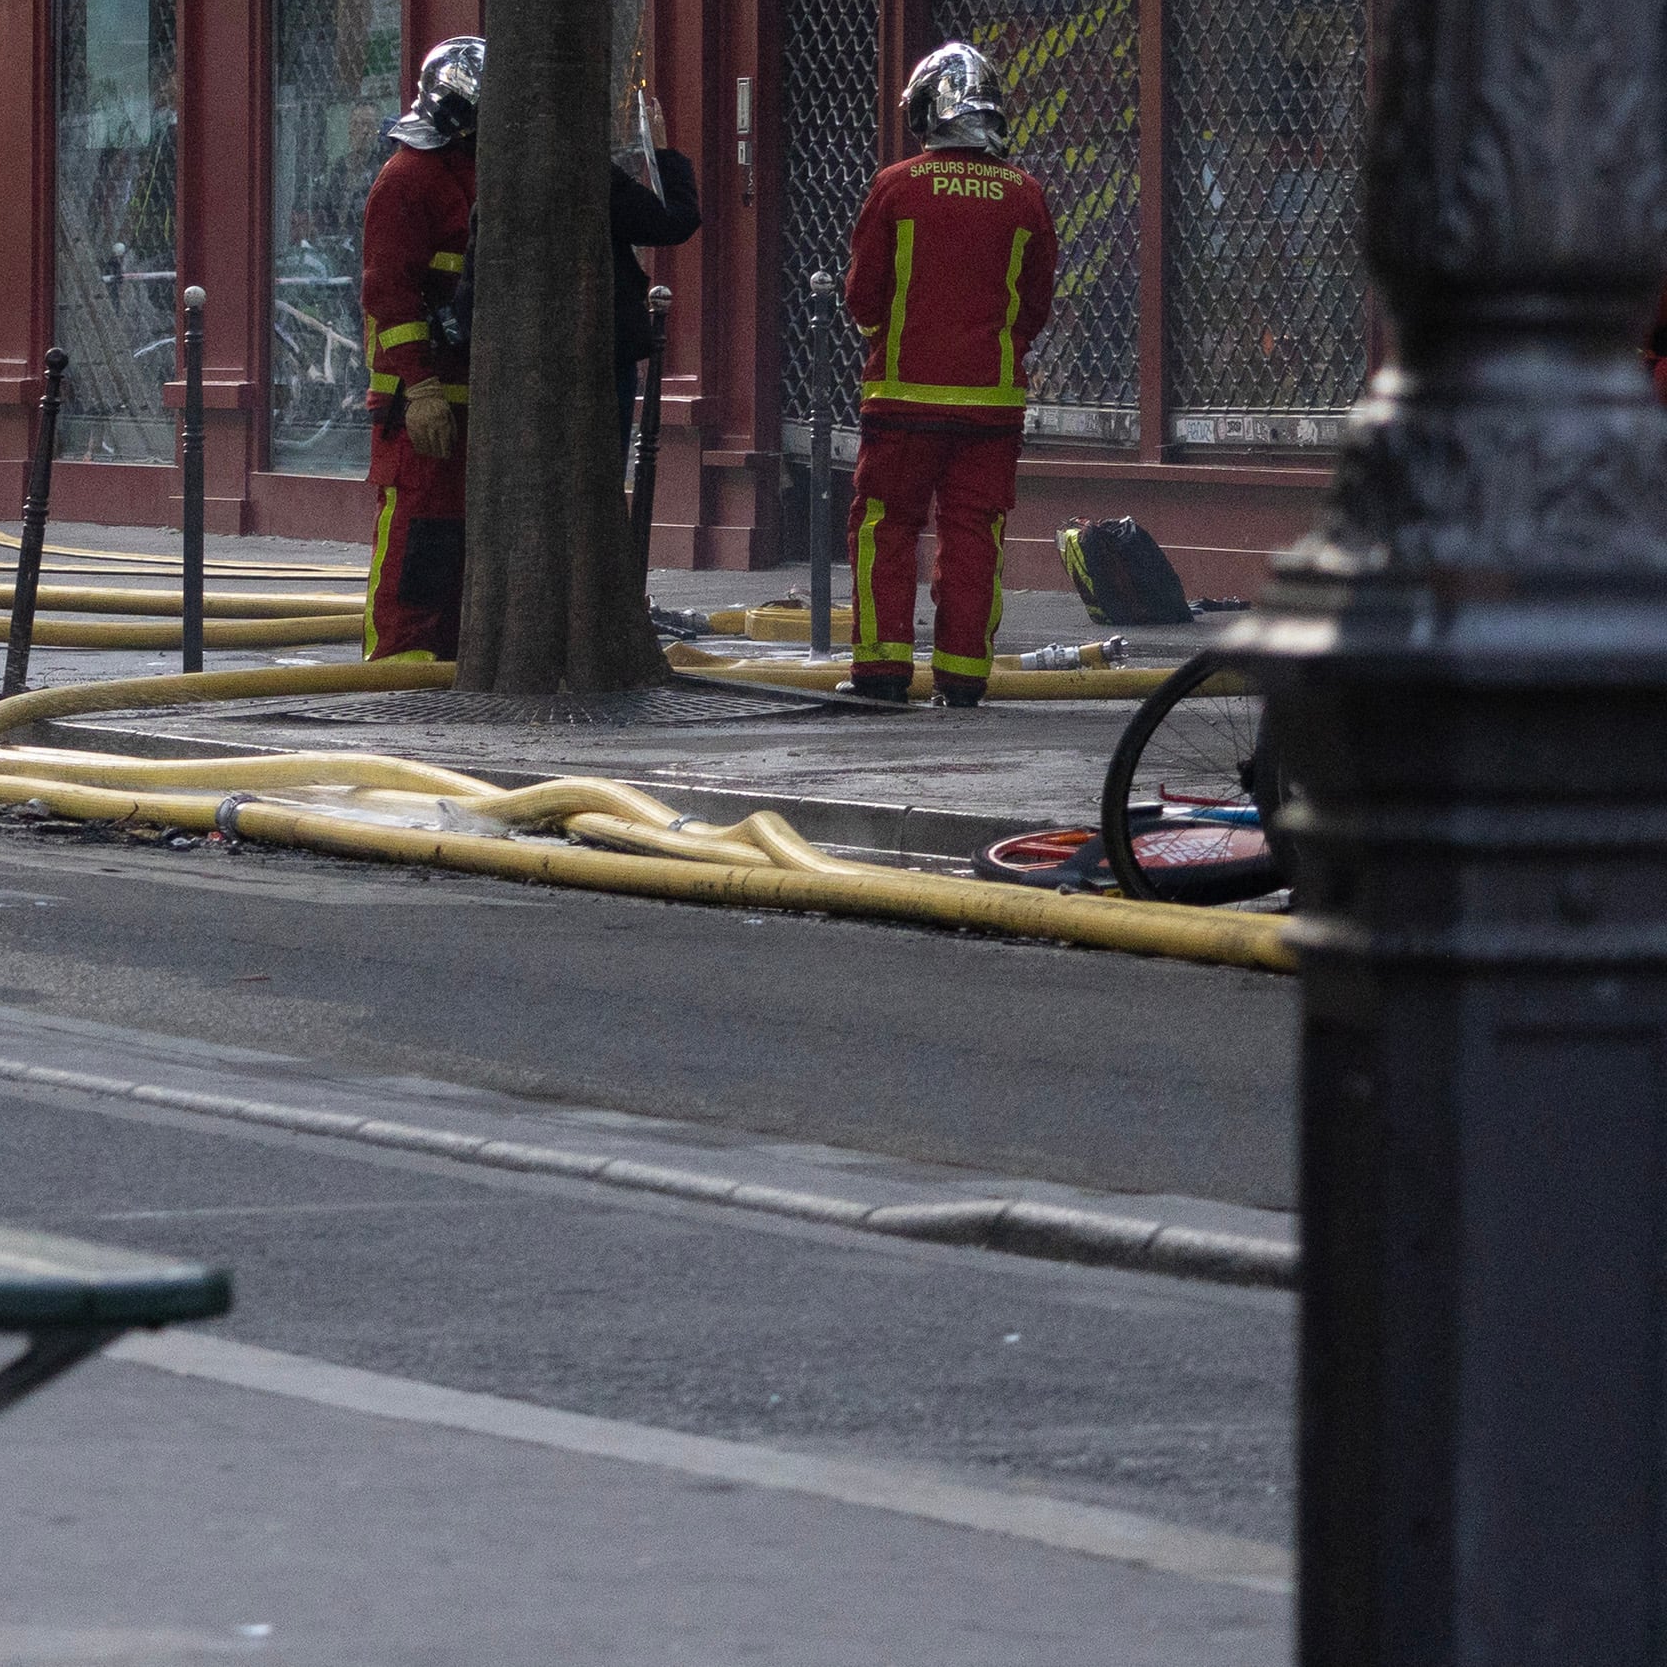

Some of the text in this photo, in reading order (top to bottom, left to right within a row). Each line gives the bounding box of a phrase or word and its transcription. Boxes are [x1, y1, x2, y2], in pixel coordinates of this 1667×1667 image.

[910, 161, 1023, 186] SAPEURS POMPIERS
[932, 177, 1004, 201] PARIS
